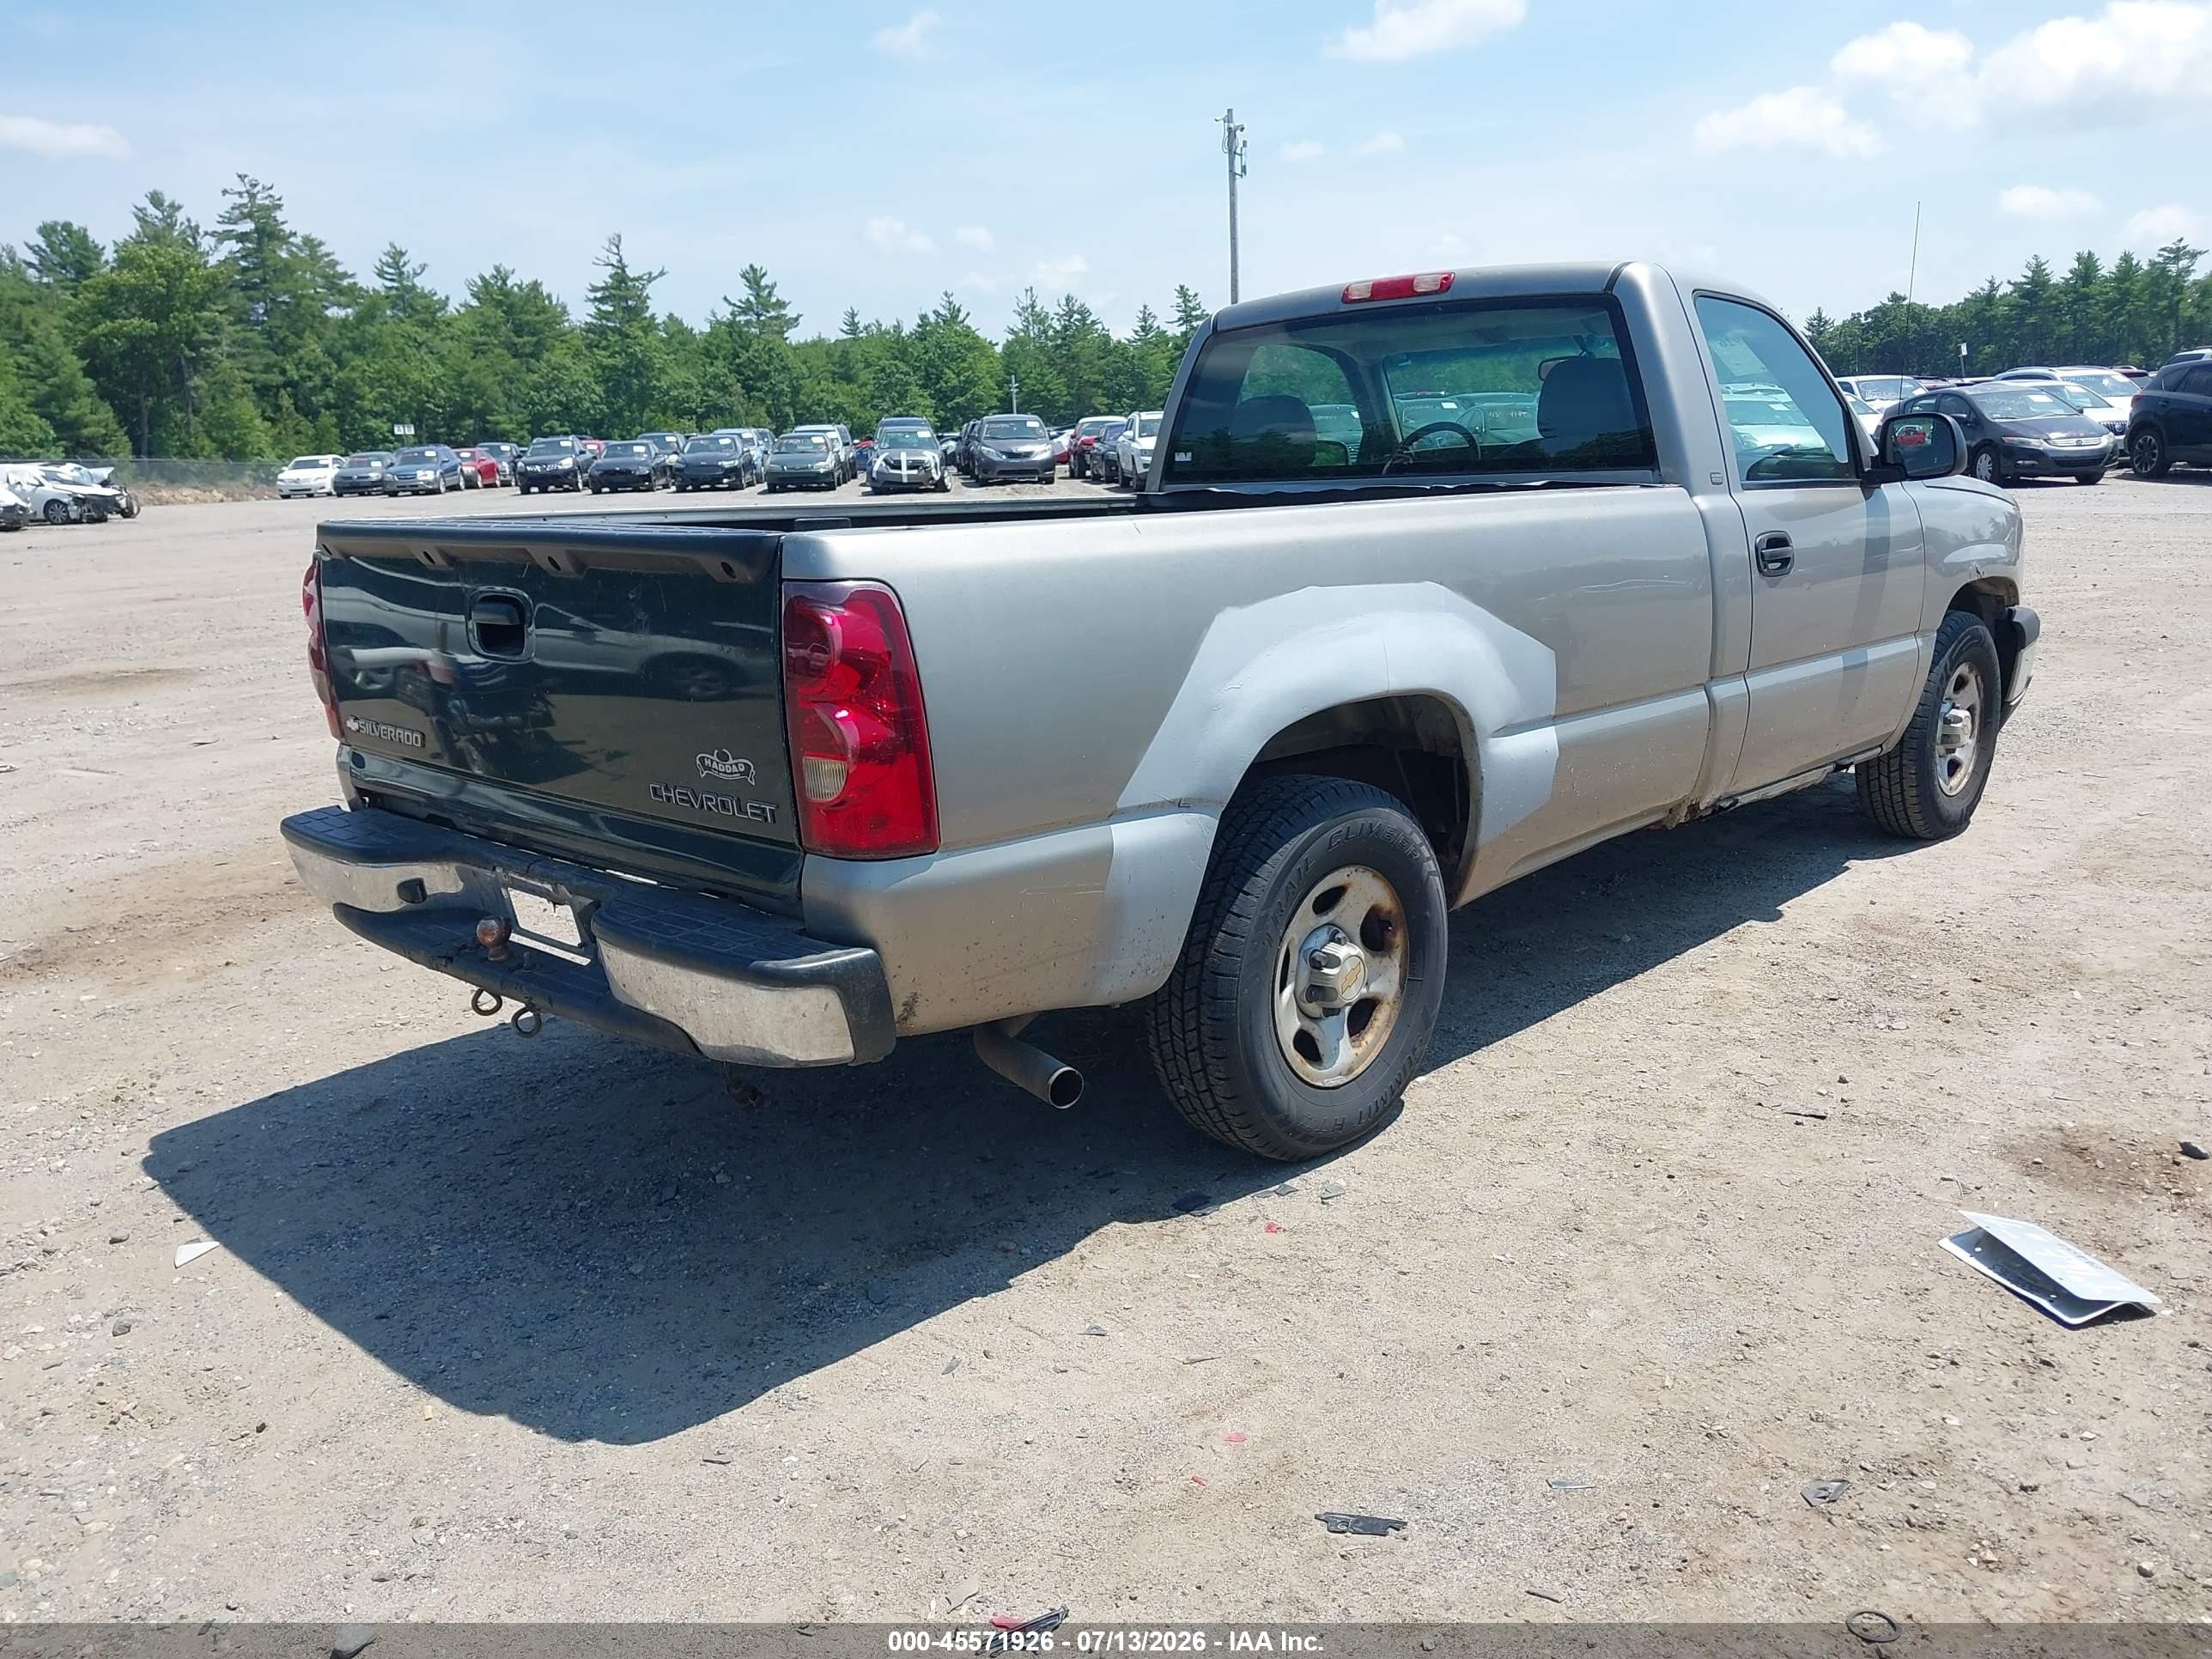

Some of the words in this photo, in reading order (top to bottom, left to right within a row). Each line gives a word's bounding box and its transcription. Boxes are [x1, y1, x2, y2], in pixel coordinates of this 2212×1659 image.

[358, 721, 422, 748] SILVERADO
[704, 757, 746, 774] HADDAD
[649, 782, 778, 823] CHEVROLET
[1327, 821, 1421, 861] CLIMBER
